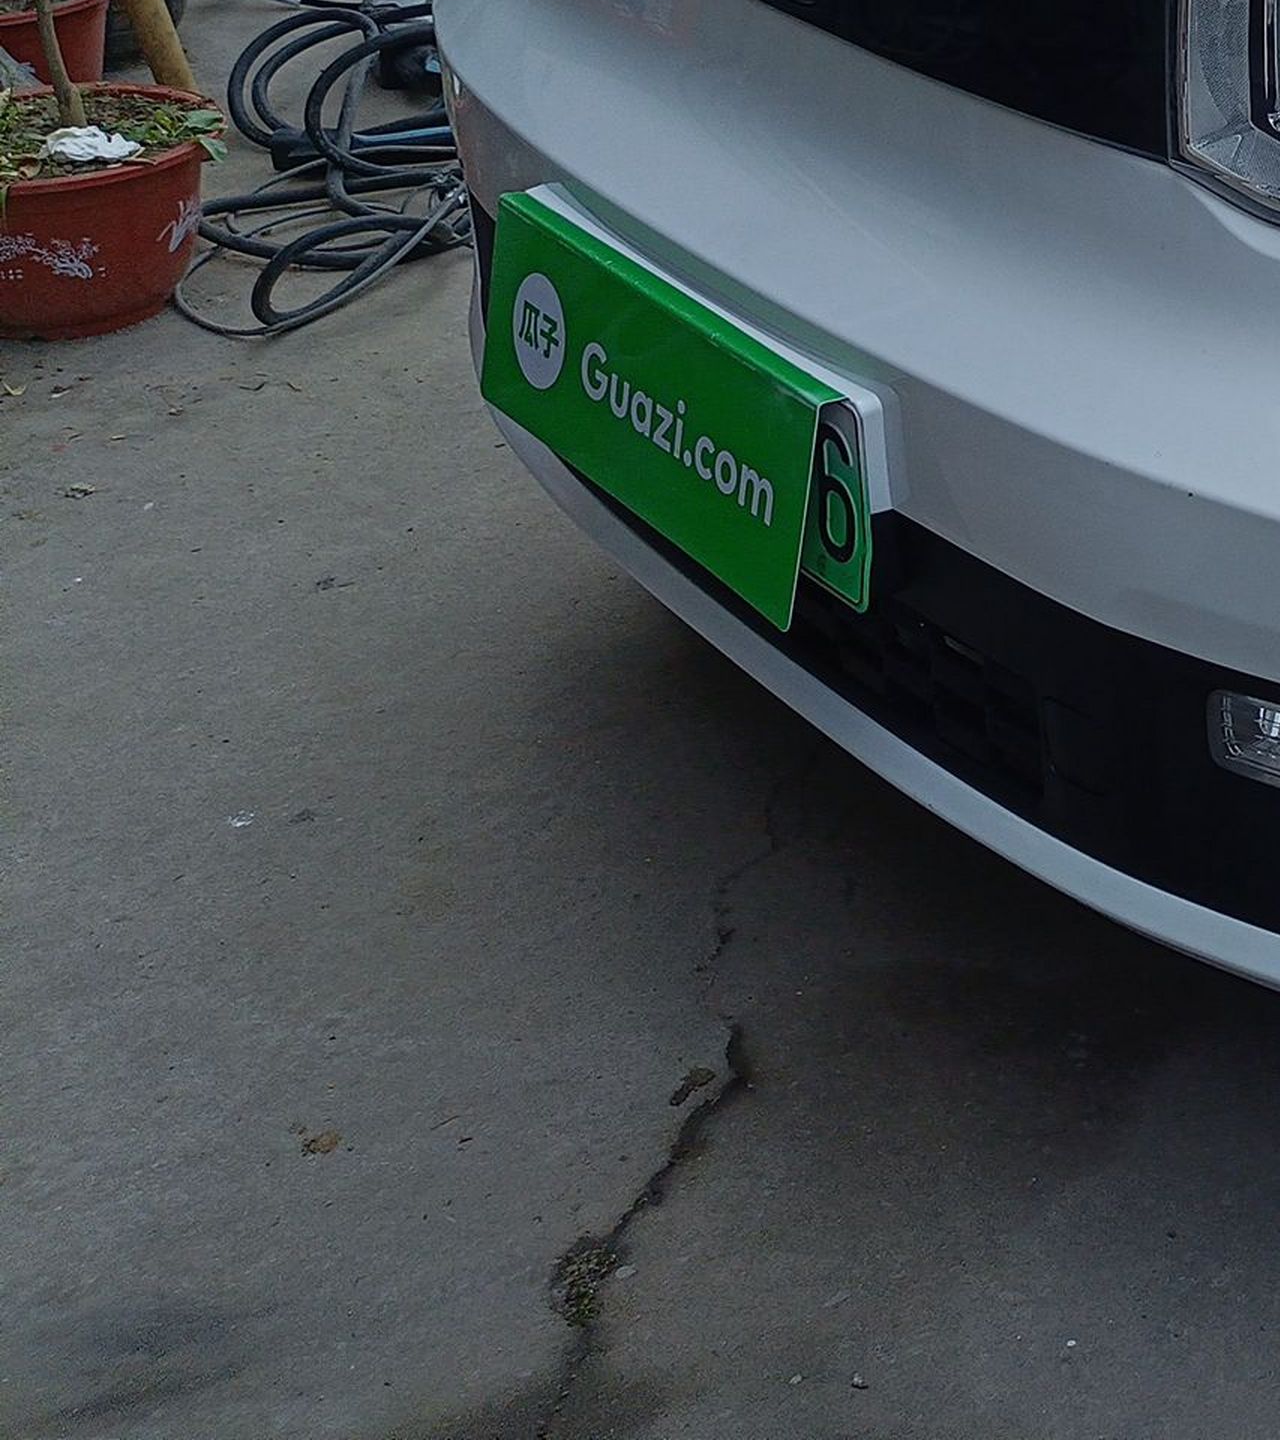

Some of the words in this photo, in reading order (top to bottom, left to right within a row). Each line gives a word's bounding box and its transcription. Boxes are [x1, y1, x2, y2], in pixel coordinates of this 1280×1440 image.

[519, 299, 560, 359] 瓜子
[581, 342, 774, 527] Guazi.com
[818, 422, 857, 564] 6
